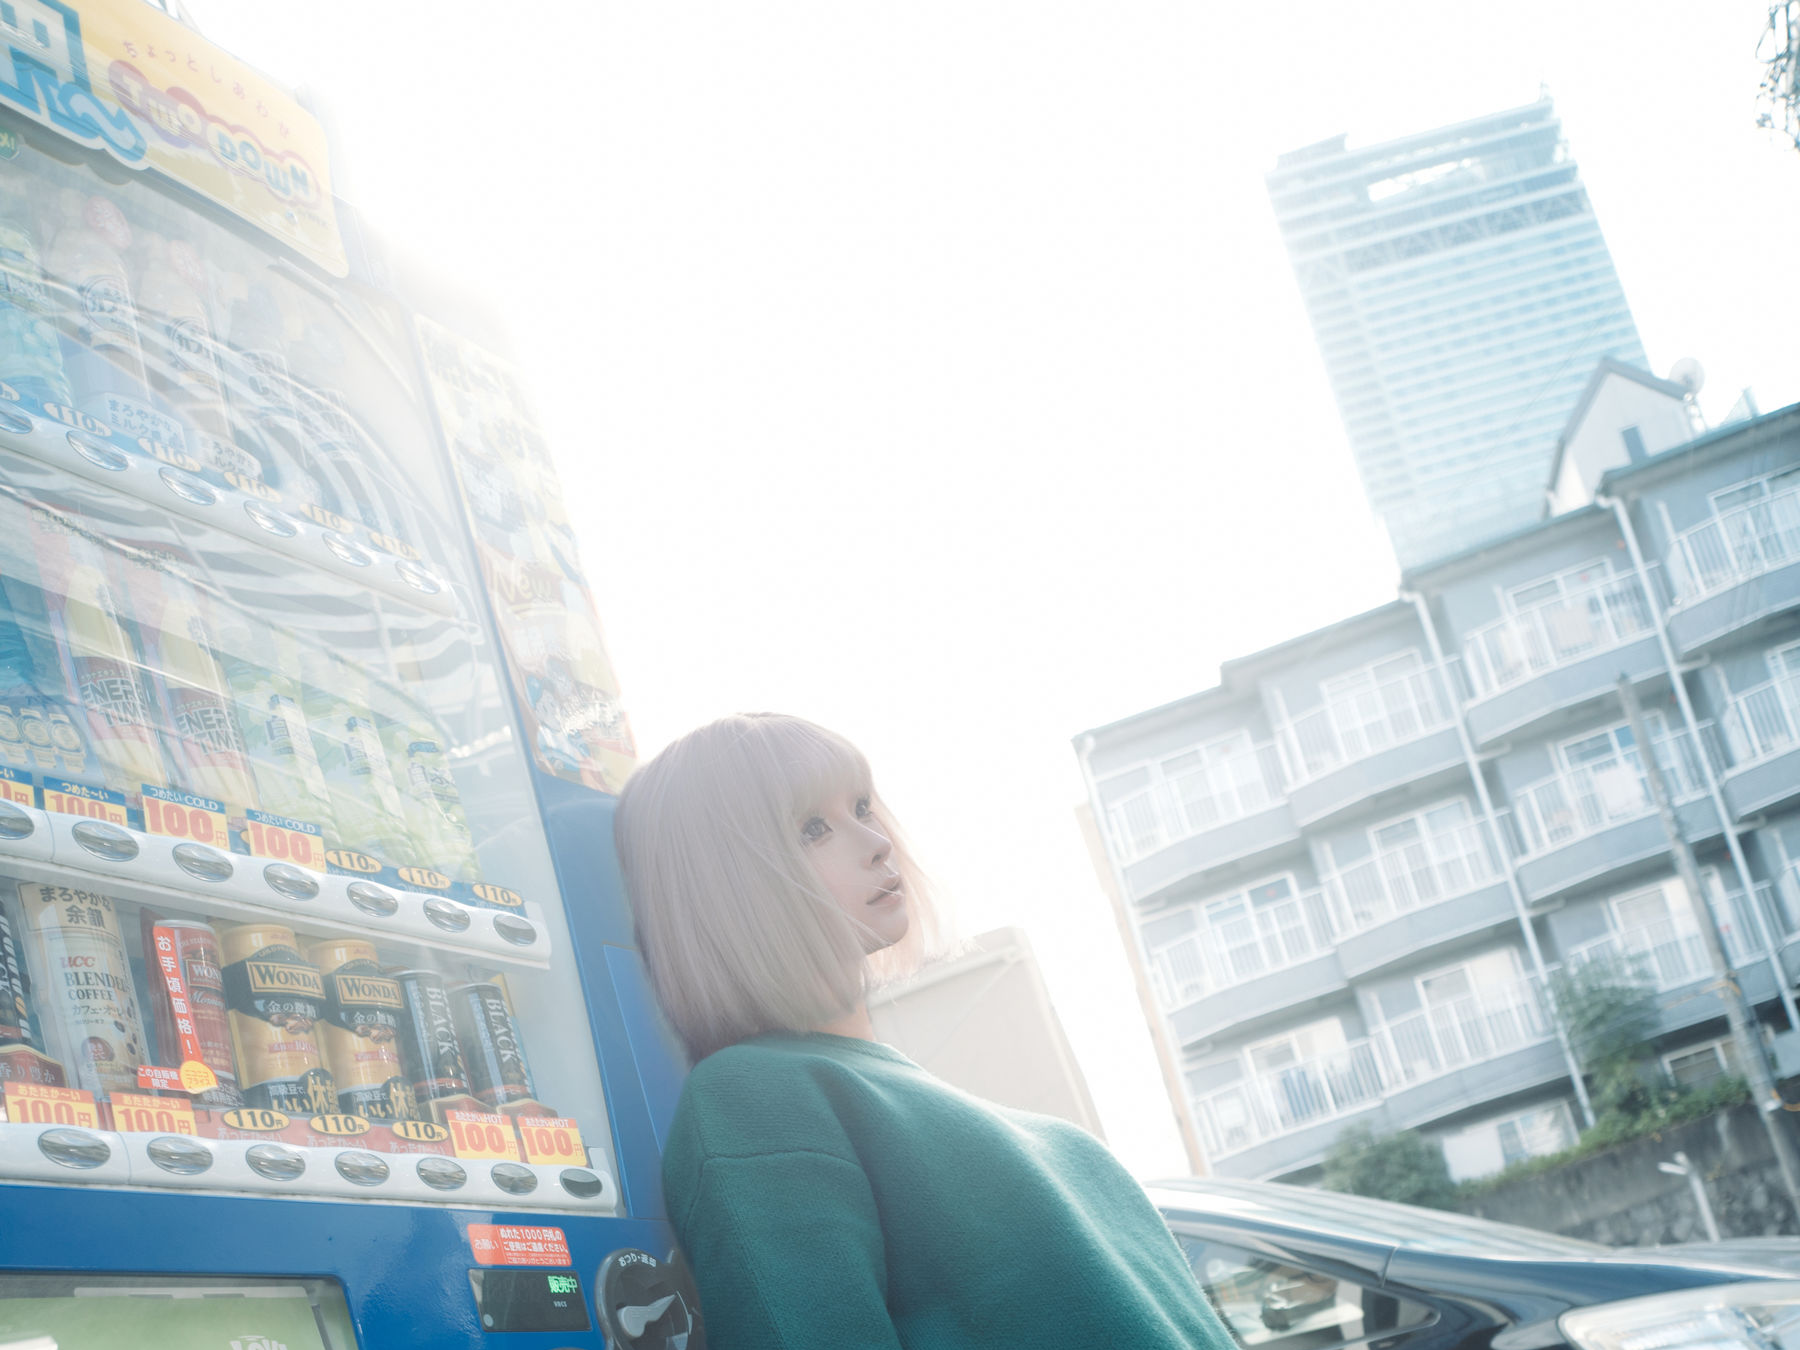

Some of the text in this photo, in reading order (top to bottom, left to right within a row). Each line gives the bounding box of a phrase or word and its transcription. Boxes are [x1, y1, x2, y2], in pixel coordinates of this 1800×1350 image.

[122, 74, 313, 199] TWO DOWN
[150, 787, 219, 811] つめたい COLD
[145, 796, 228, 848] 100円
[284, 818, 316, 835] COLD
[249, 821, 325, 870] 100円
[39, 886, 113, 912] まろやかな
[60, 955, 96, 969] UCC
[252, 963, 321, 991] WONDA
[342, 977, 399, 1000] WONDA
[68, 988, 116, 1001] COFFEE
[425, 986, 451, 1055] BLACK
[485, 998, 515, 1063] BLACK
[233, 1109, 284, 1129] 110円
[318, 1114, 366, 1133] 110円
[400, 1121, 444, 1140] 110円
[484, 1114, 504, 1125] HOT
[550, 1118, 570, 1129] HOT
[450, 1121, 518, 1155] 100円
[521, 1128, 585, 1157] 100円
[547, 1275, 579, 1294] 販売中
